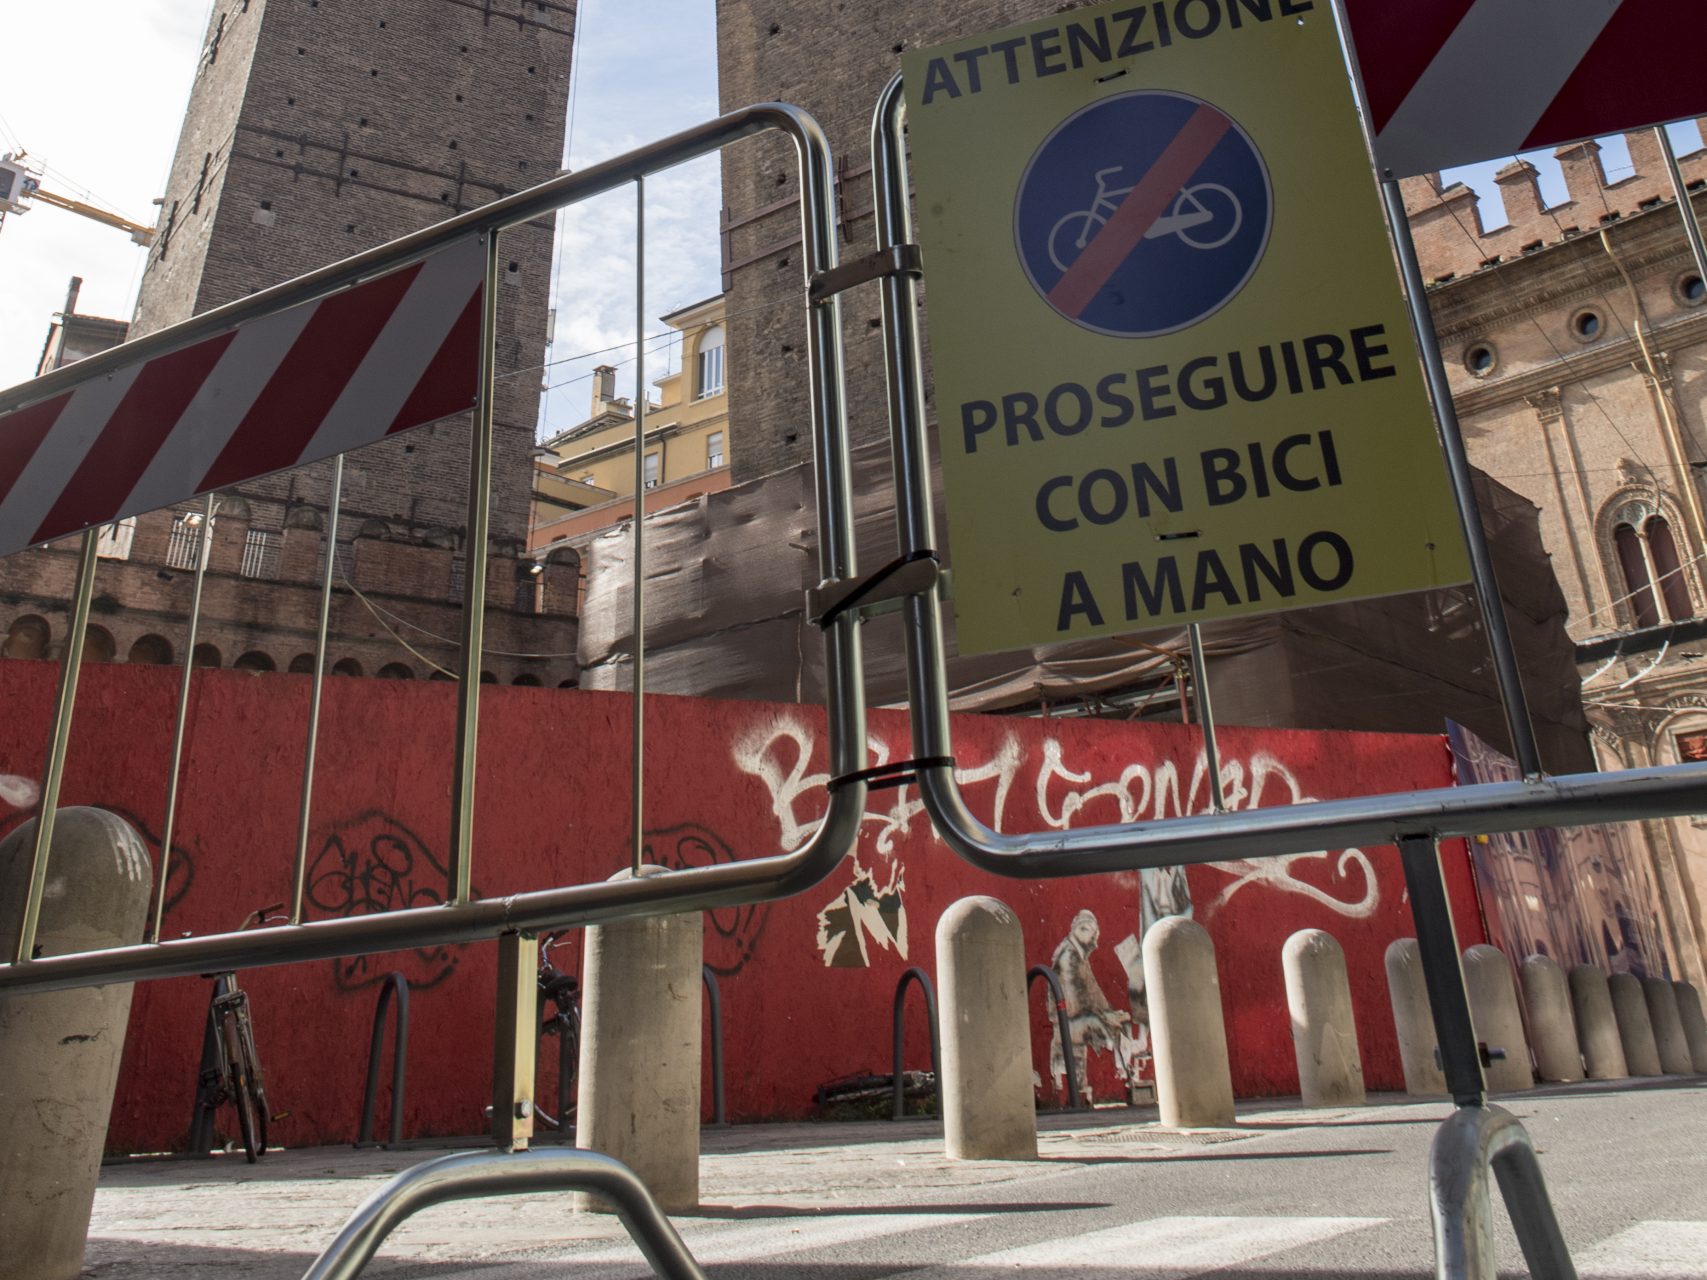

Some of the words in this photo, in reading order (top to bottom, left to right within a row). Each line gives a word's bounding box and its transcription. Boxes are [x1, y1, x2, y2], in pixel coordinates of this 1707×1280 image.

[961, 324, 1397, 453] PROSEGUIRE
[1036, 457, 1183, 532] CON
[1201, 430, 1342, 506] BICI
[1057, 571, 1104, 631] A
[1122, 531, 1354, 620] MANO
